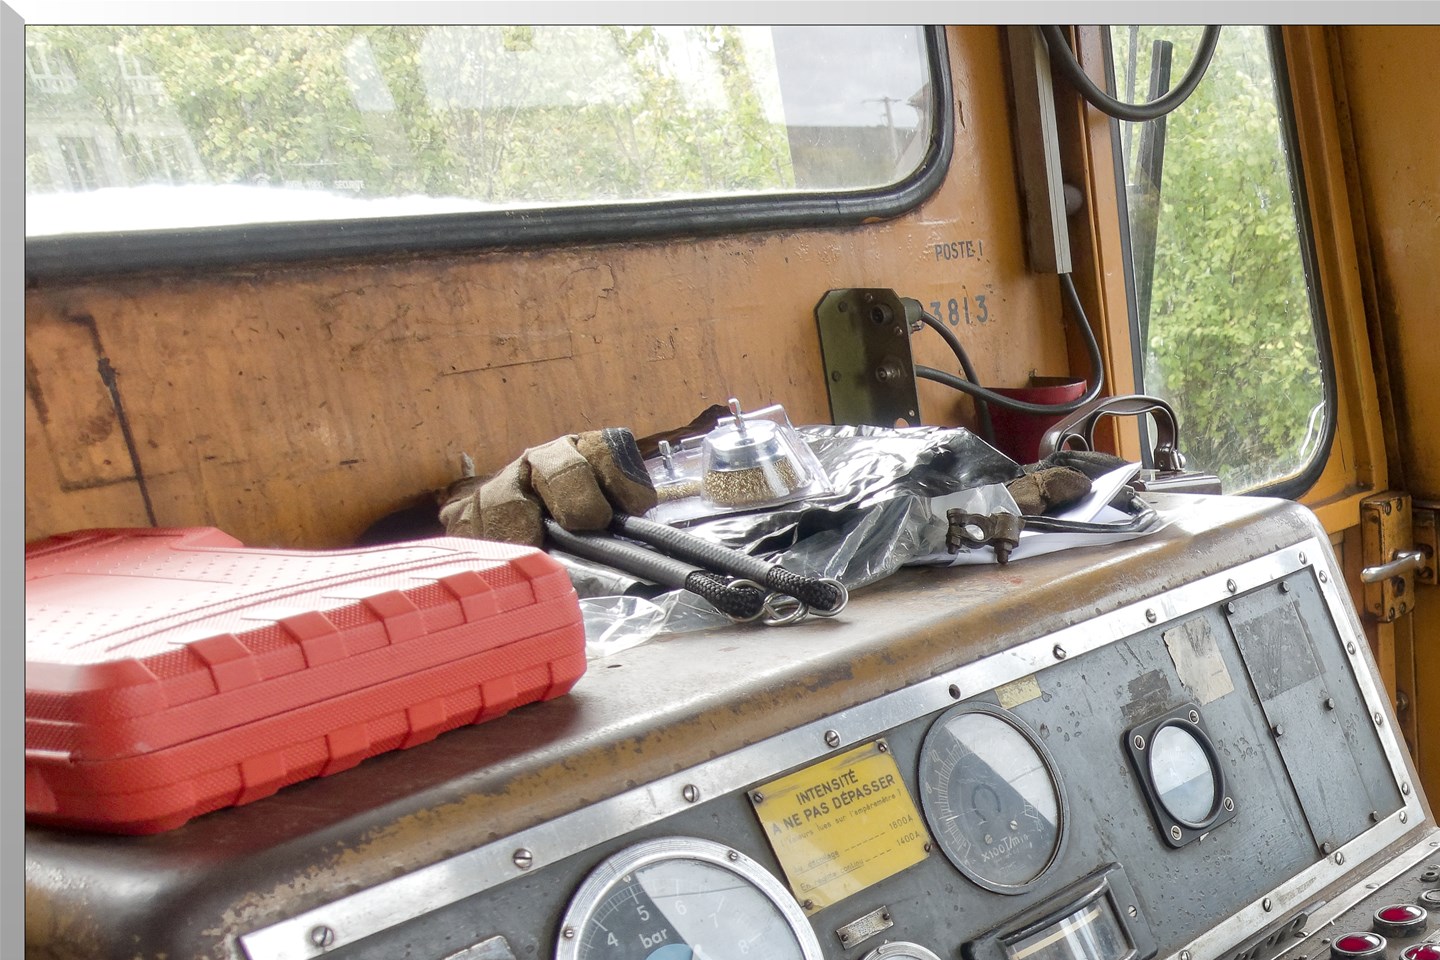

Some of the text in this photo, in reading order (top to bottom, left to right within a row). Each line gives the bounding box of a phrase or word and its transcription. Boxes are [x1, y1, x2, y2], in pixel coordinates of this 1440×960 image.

[935, 240, 975, 262] POSTE
[930, 295, 989, 326] 3813
[796, 769, 859, 806] INTENSITÉ
[773, 774, 896, 836] A NE PAS DÉPASSER
[889, 814, 913, 831] 1800A
[896, 830, 921, 846] 1400A
[637, 905, 650, 921] 5
[675, 900, 688, 915] 6
[607, 932, 619, 947] 4
[639, 927, 669, 949] bar
